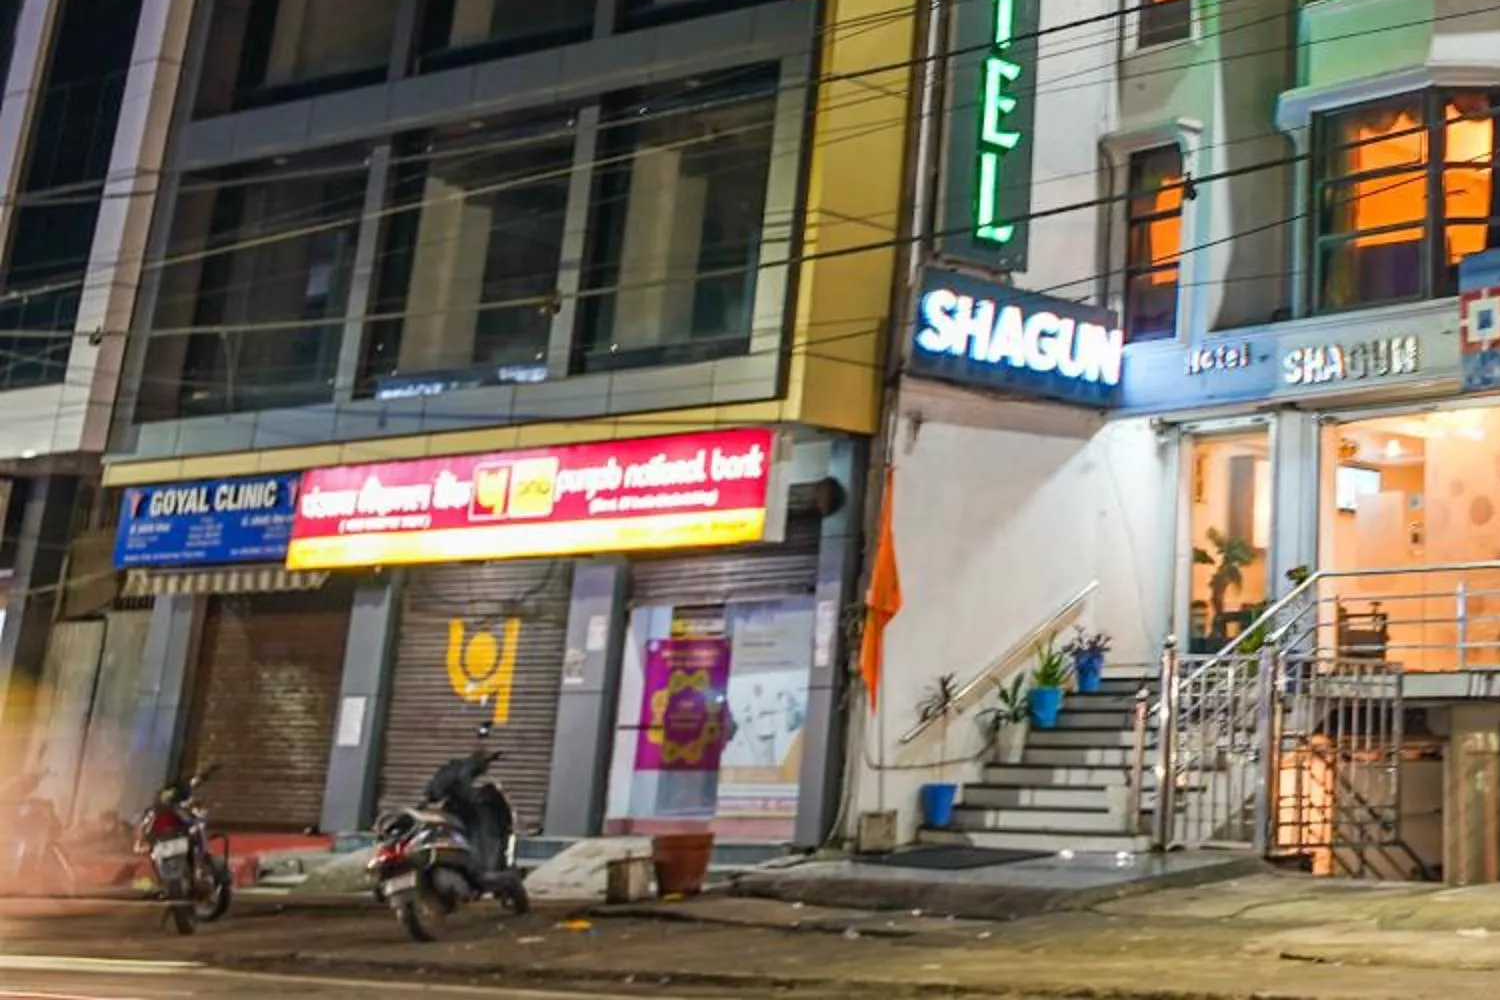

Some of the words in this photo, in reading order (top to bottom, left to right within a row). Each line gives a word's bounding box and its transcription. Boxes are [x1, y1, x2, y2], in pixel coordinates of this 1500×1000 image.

[916, 289, 1123, 386] SHAGUN
[1186, 343, 1249, 375] Hotel
[1283, 335, 1419, 384] SHAGUN
[150, 486, 209, 517] GOYAL
[214, 479, 277, 513] CLINIC
[555, 457, 623, 501] punjab
[624, 450, 707, 488] national
[711, 444, 764, 481] bank
